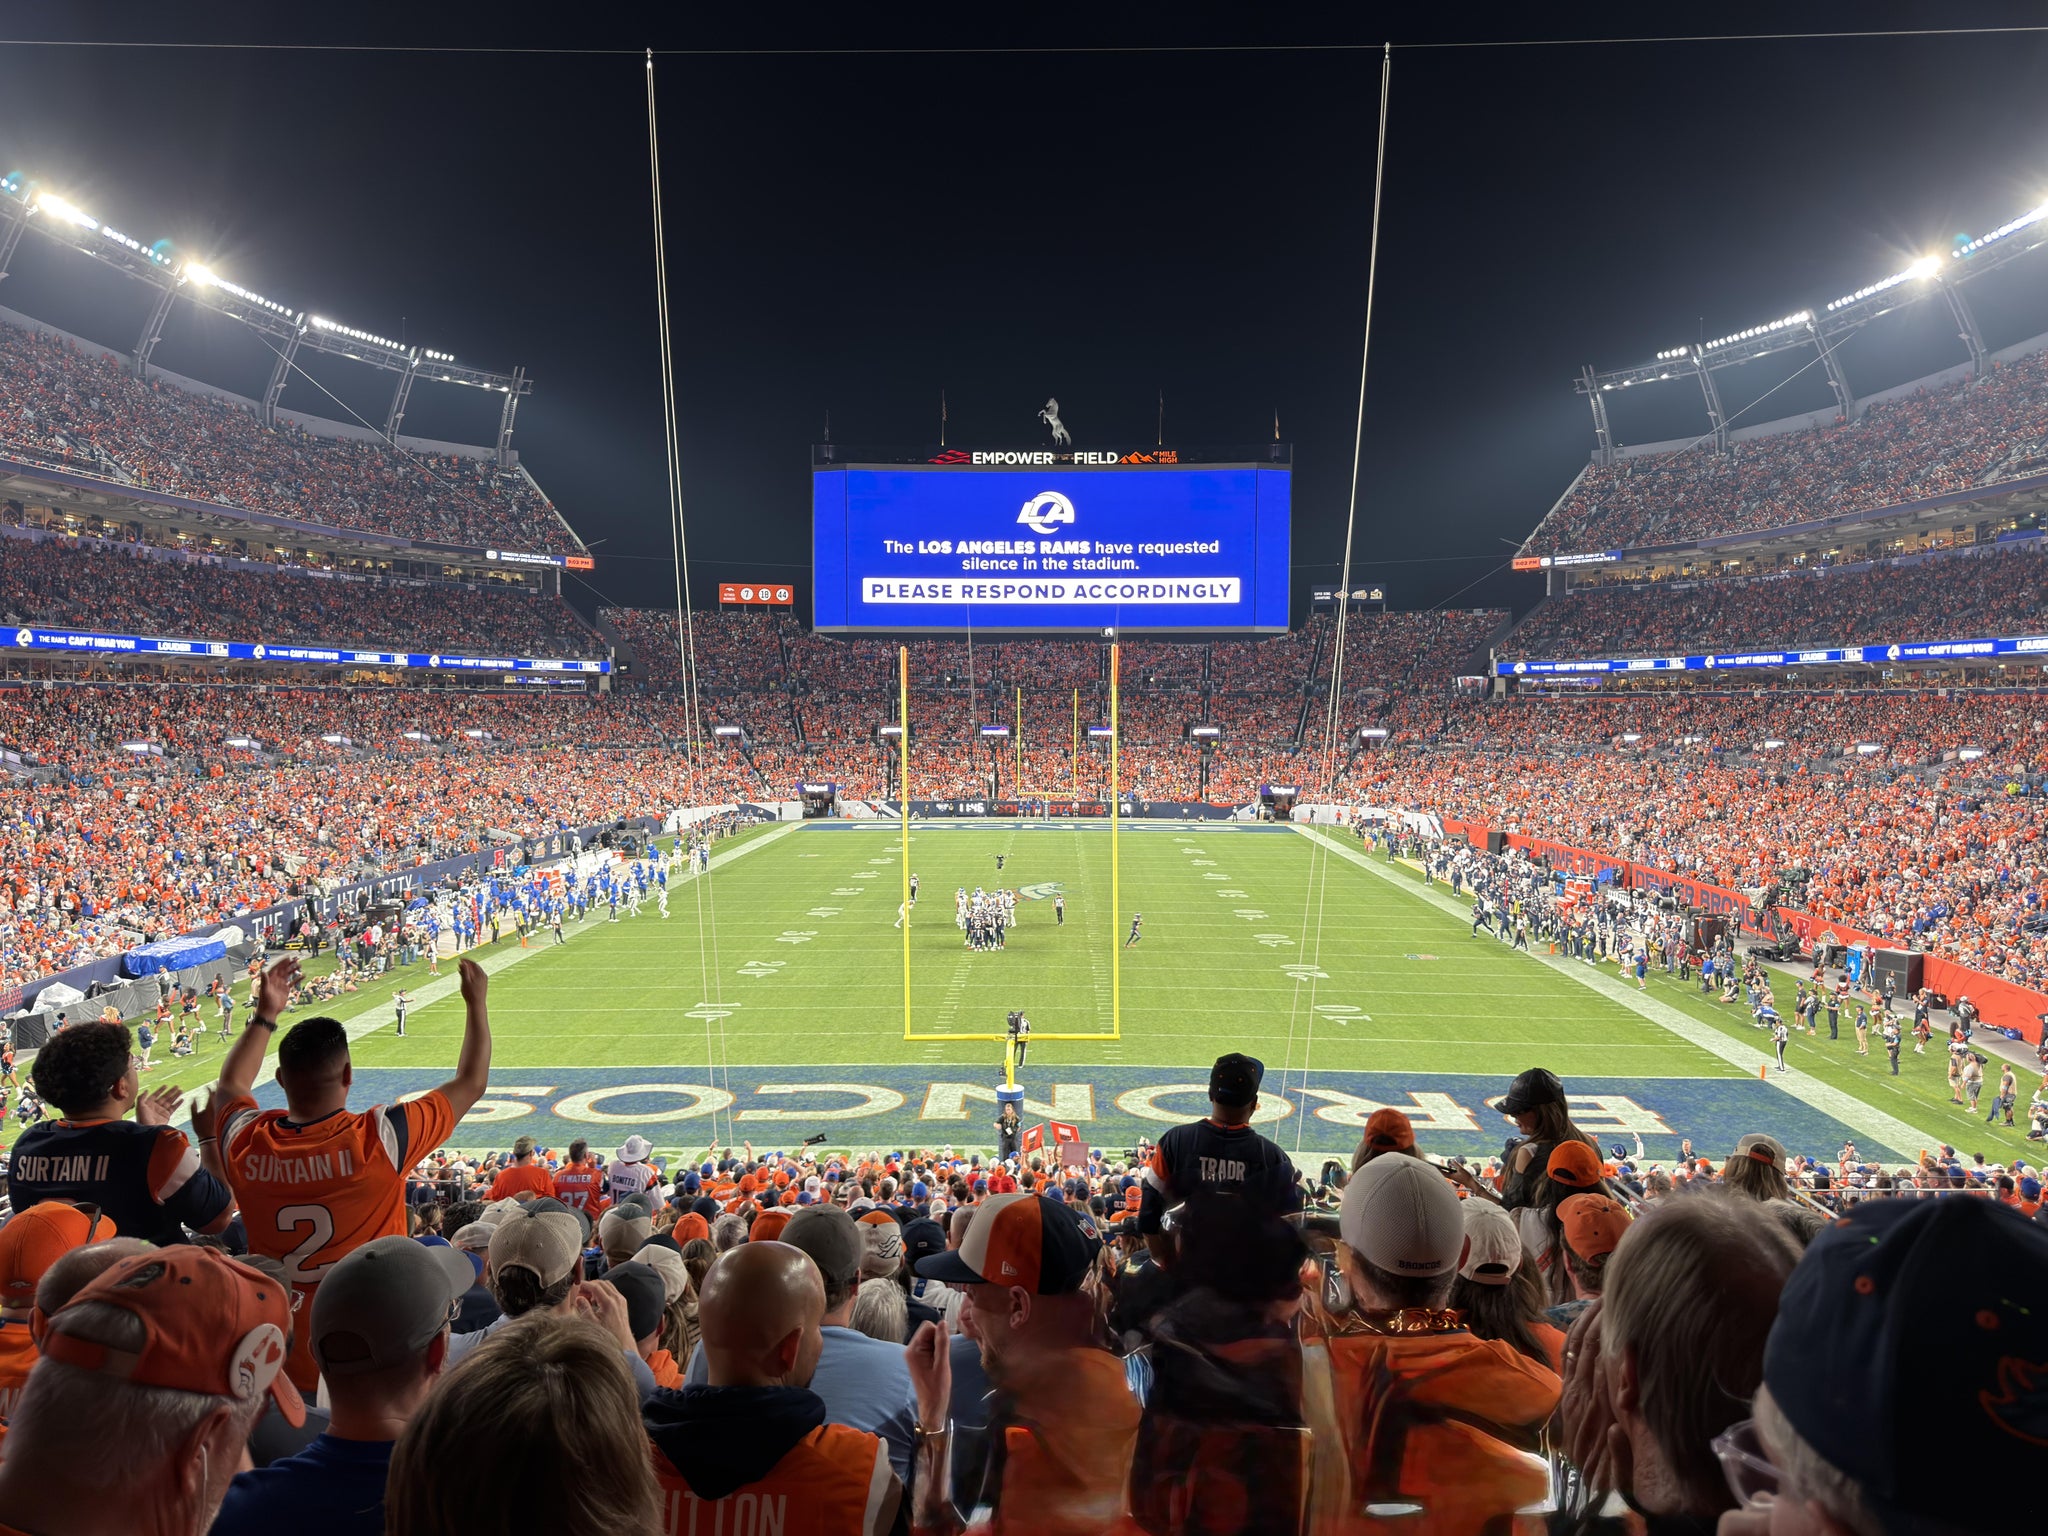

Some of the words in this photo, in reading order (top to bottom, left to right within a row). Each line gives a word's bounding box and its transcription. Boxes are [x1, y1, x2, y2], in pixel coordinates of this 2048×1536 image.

[972, 451, 1053, 465] EMPOWER
[1074, 451, 1119, 465] FIELD
[883, 540, 914, 554] The
[918, 540, 952, 554] LOS
[956, 540, 1036, 554] ANGELES
[1040, 540, 1091, 554] RAMS
[1095, 540, 1134, 554] have
[1138, 540, 1219, 558] requested
[962, 556, 1019, 571] silence
[1023, 556, 1038, 570] in
[1042, 556, 1068, 571] the
[1072, 556, 1140, 571] stadium.
[761, 591, 769, 599] 18
[871, 584, 953, 599] PLEASE
[961, 584, 1066, 599] RESPOND
[1074, 584, 1232, 599] ACCORDINGLY
[68, 636, 93, 646] CAN'T
[94, 638, 116, 648] HEAR
[116, 639, 135, 649] YOU!
[157, 642, 192, 651] LOUDER
[1928, 644, 1951, 655] CAN'T
[1952, 643, 1974, 654] HEAR
[1974, 642, 1993, 652] YOU!
[2016, 638, 2048, 651] LOUDE
[998, 804, 1042, 815] SOUH
[1049, 804, 1104, 815] STANDS
[852, 823, 1241, 831] BRONCOS
[1541, 845, 1573, 869] HOME
[1636, 871, 1695, 905] DENER
[775, 930, 818, 943] 30
[1253, 933, 1296, 947] 30
[737, 960, 787, 976] 20
[1280, 964, 1330, 979] 20
[684, 1001, 742, 1018] 10
[1314, 1004, 1373, 1022] 10
[395, 1082, 1676, 1135] BRONCOS
[16, 1155, 92, 1182] SURTAIN
[94, 1155, 110, 1181] II
[245, 1153, 334, 1184] SURTAIN
[338, 1149, 353, 1176] II
[558, 1174, 592, 1183] ATWATER
[612, 1174, 636, 1187] BONITTO
[276, 1203, 340, 1284] 2
[1398, 1260, 1441, 1270] BRONCOS
[661, 1489, 787, 1536] UTTON
